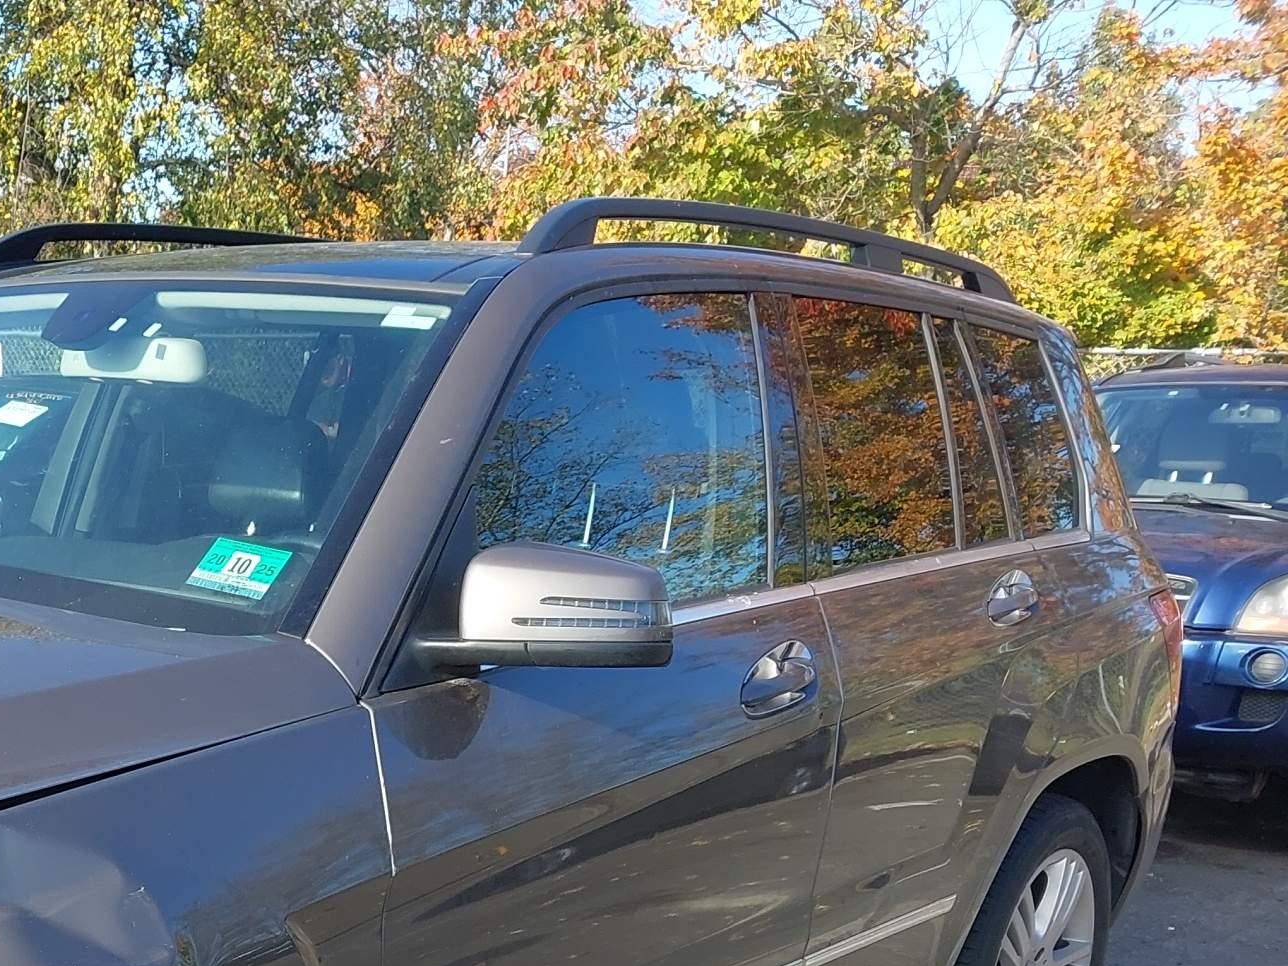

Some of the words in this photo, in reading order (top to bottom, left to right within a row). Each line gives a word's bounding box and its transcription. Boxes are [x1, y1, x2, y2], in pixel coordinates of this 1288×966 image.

[207, 552, 227, 566] 20
[226, 556, 253, 575] 10
[255, 563, 276, 577] 25
